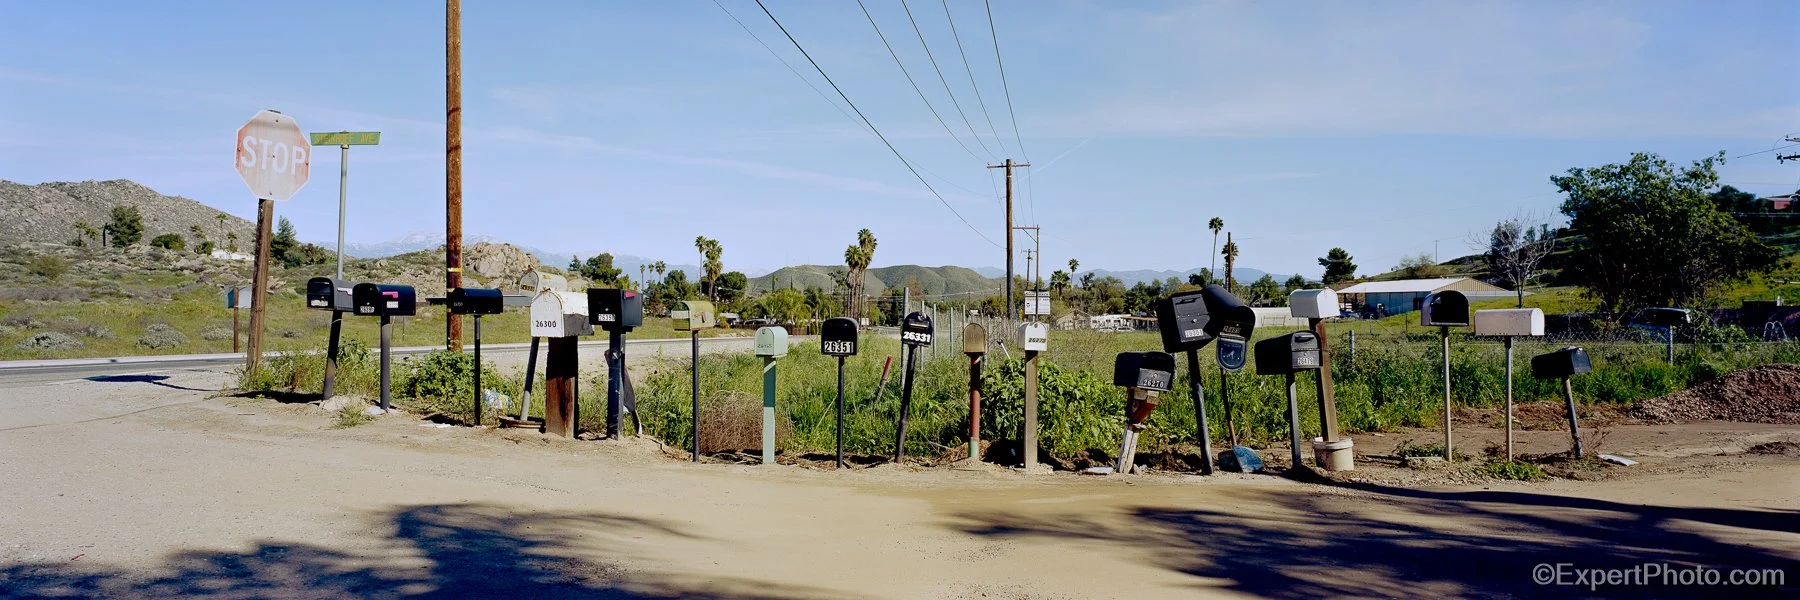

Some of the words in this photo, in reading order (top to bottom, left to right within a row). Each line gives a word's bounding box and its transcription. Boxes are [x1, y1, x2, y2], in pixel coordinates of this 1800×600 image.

[241, 135, 306, 175] STOP
[536, 320, 557, 328] 26300
[903, 331, 931, 343] 26331
[825, 341, 853, 353] 26351
